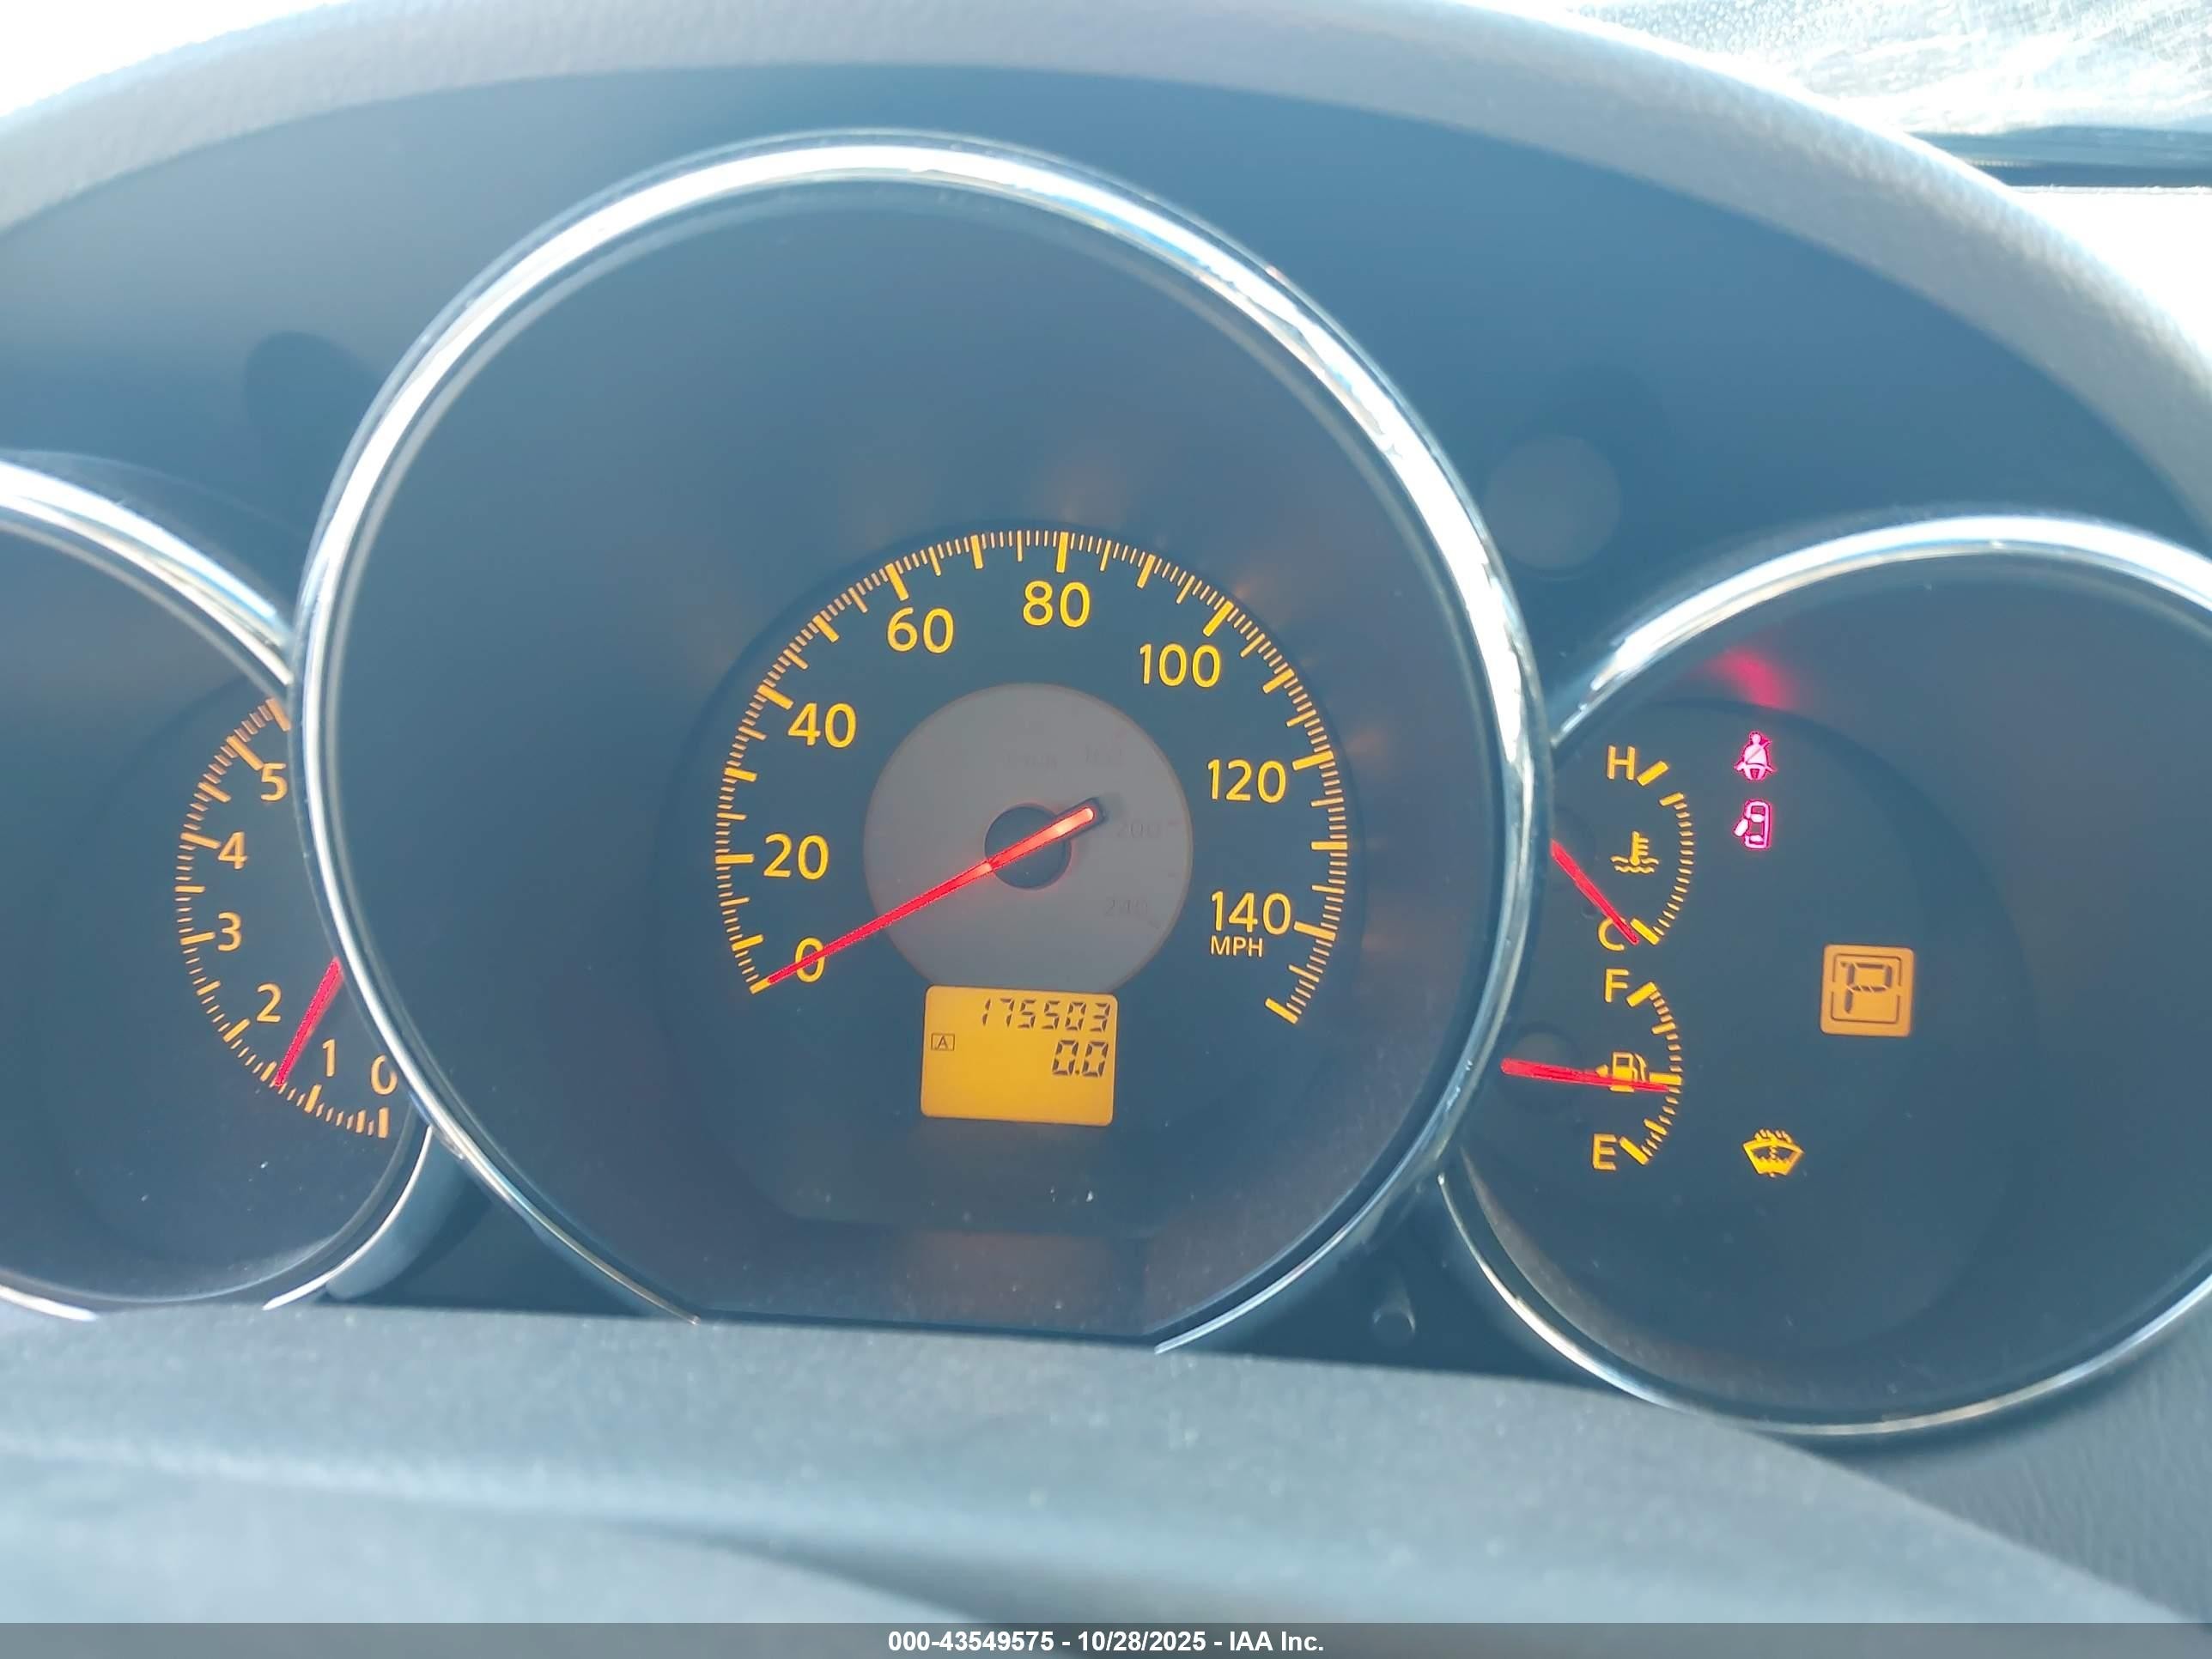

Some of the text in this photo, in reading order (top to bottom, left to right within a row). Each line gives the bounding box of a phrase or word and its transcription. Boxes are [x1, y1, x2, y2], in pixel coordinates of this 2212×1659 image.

[1022, 580, 1091, 628] 80
[886, 606, 955, 653] 60
[1138, 643, 1221, 688] 100
[787, 702, 857, 748] 40
[1206, 758, 1286, 804] 120
[1607, 745, 1636, 780] H
[259, 763, 288, 802] 5
[216, 831, 248, 870] 4
[763, 833, 830, 880] 20
[216, 912, 242, 951] 3
[1209, 890, 1291, 935] 140
[1210, 935, 1264, 958] MPH
[1597, 916, 1626, 951] C
[793, 938, 825, 983] 0
[256, 982, 283, 1022] 2
[1603, 969, 1630, 1003] F
[1839, 961, 1893, 1015] P
[981, 997, 1111, 1032] 175503
[321, 1039, 337, 1078] 1
[370, 1054, 398, 1096] 0
[1052, 1039, 1109, 1078] 0.0
[1591, 1133, 1617, 1170] E
